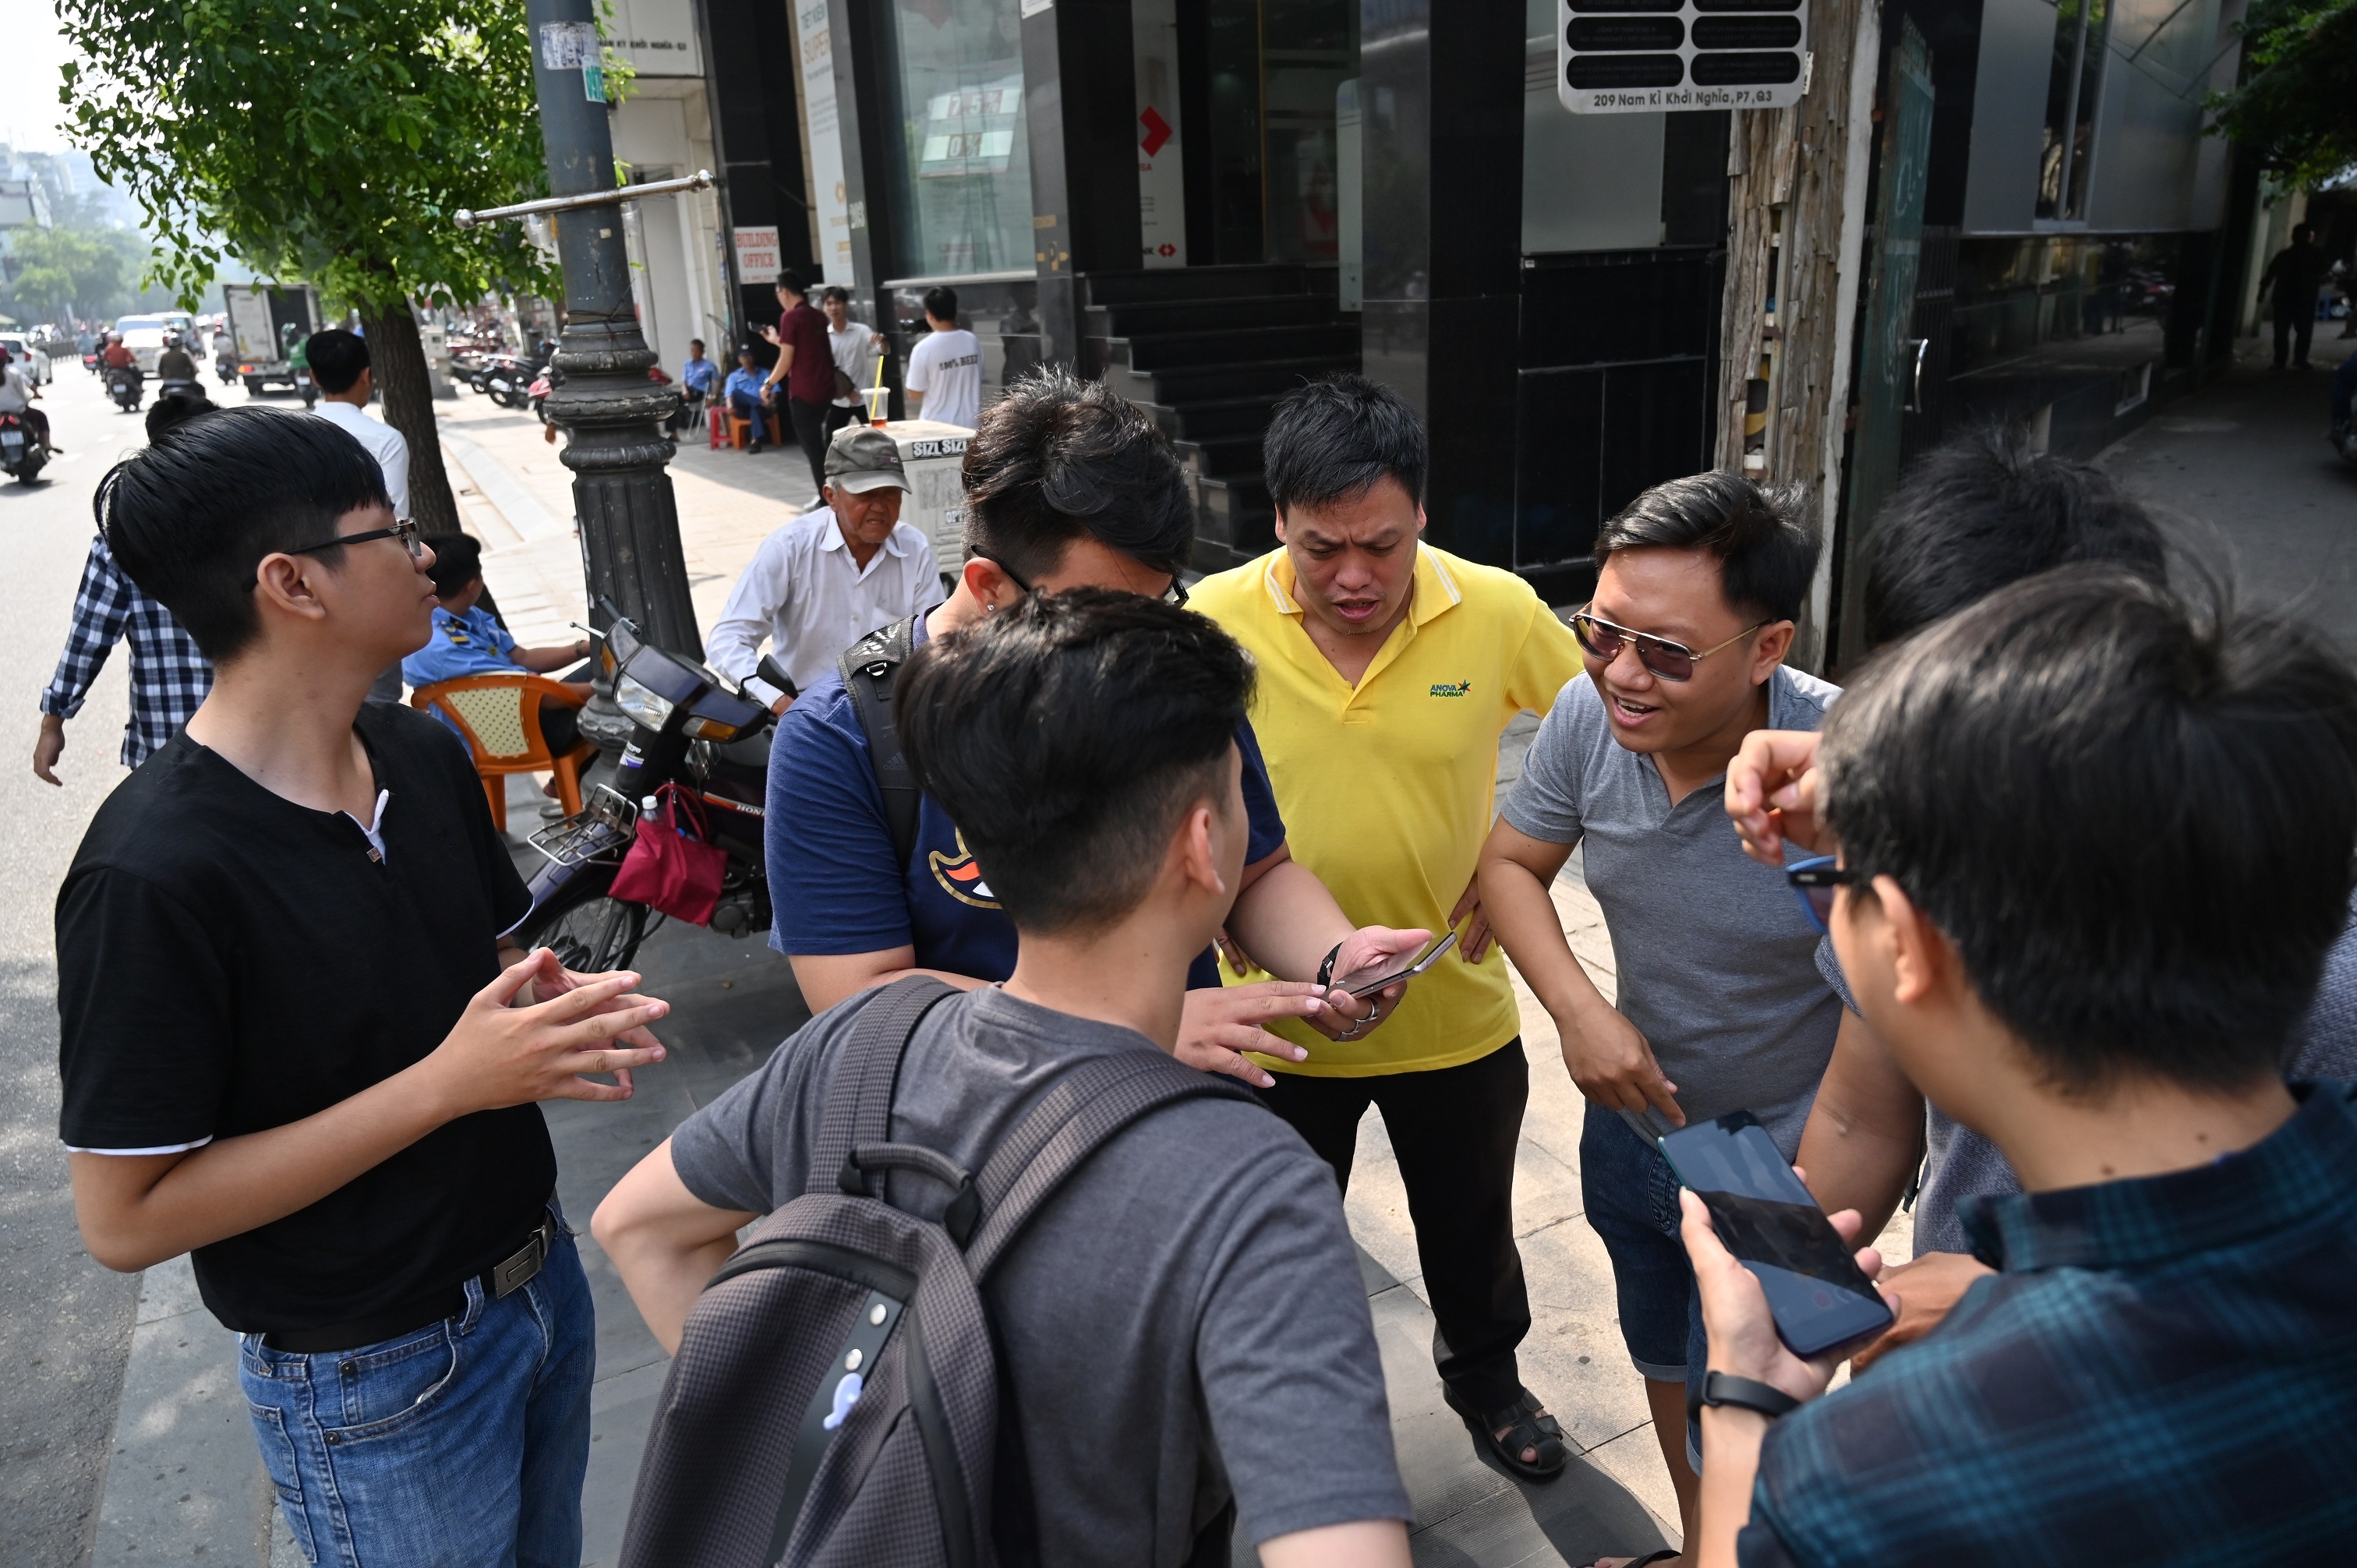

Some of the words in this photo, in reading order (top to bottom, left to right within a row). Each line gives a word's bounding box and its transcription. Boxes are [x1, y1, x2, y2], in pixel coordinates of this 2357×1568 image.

[1594, 94, 1616, 107] 209
[1618, 94, 1645, 106] Nam
[736, 232, 778, 248] BUILDING
[744, 253, 776, 269] OFFICE
[913, 442, 942, 457] SIZL
